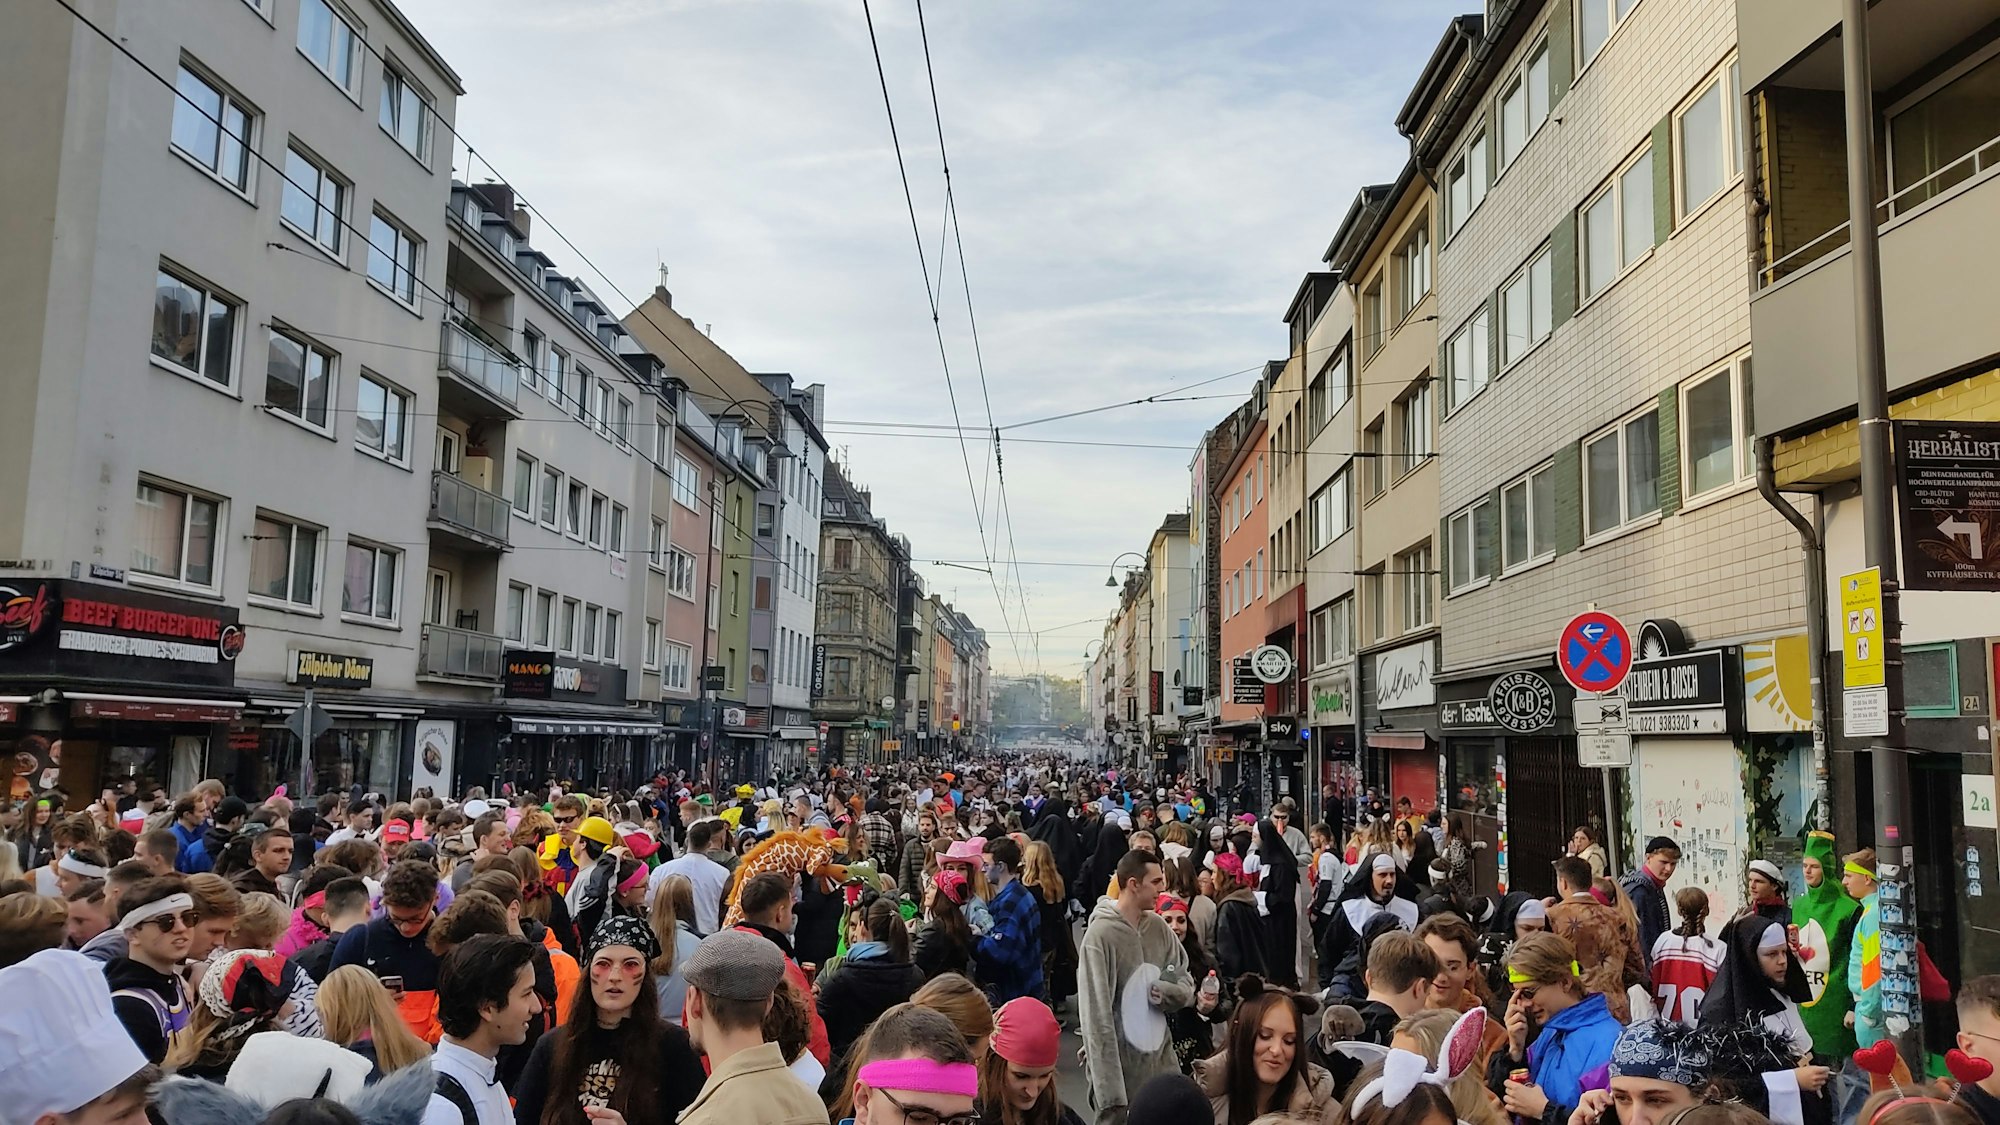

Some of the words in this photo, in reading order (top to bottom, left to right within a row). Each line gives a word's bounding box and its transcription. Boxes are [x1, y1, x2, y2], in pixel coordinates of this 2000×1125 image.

[1908, 479, 1956, 487] HOCHWERTIGE
[1936, 472, 1981, 480] FACHHANDEL
[1981, 471, 1995, 479] FÜR
[1915, 489, 1955, 497] CBD-BLÜTEN
[1926, 570, 1996, 579] KYFFHÄUSERSTR.
[64, 598, 118, 628] BEEF
[121, 606, 188, 638] BURGER
[189, 616, 221, 641] ONE
[299, 652, 343, 682] Zülpicher
[344, 658, 371, 681] Döner
[509, 663, 552, 676] MANGO
[1235, 668, 1241, 676] T
[1496, 674, 1550, 698] FRISEUR
[1662, 667, 1670, 700] &
[1671, 664, 1699, 700] BOSCH
[1511, 690, 1535, 713] K&B
[1964, 697, 1979, 710] 2A
[1496, 706, 1550, 730] 9383320
[1640, 715, 1657, 733] 0221
[1659, 712, 1691, 732] 9383320
[1270, 721, 1292, 735] sky
[1969, 790, 1991, 812] 2a
